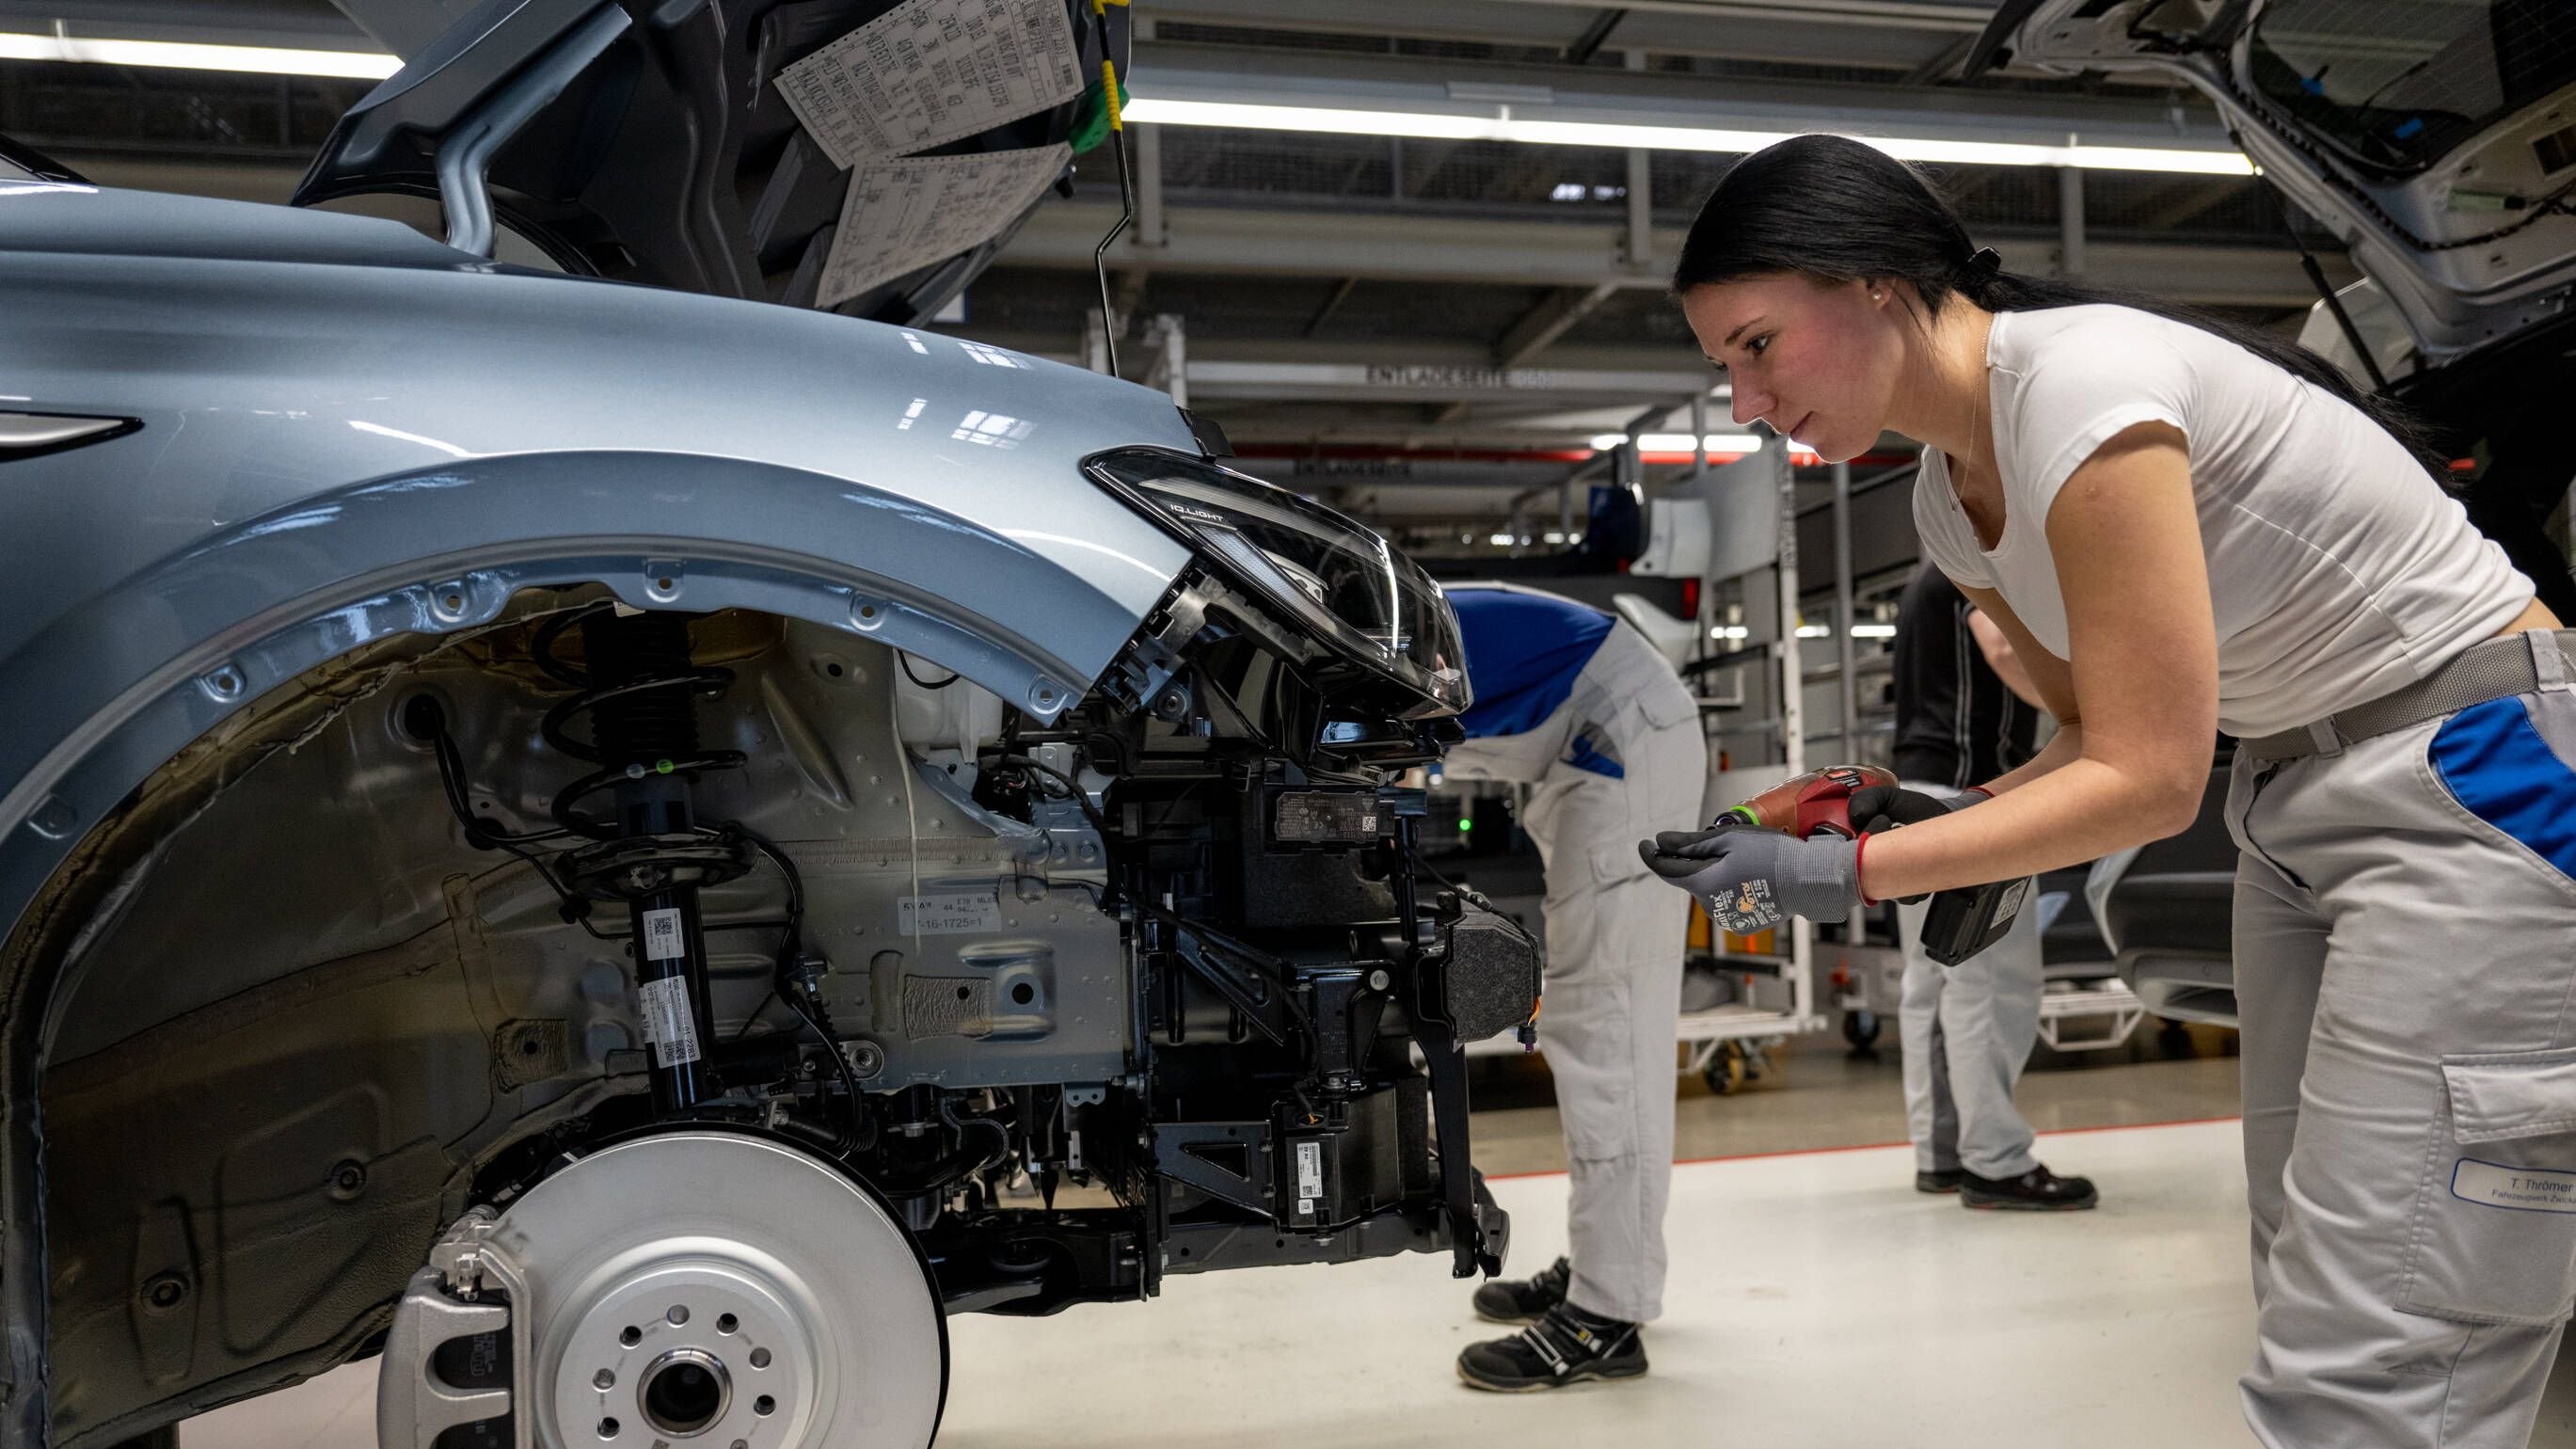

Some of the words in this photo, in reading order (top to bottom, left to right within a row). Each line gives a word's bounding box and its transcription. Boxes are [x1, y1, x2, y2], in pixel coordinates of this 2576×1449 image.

[1170, 504, 1223, 521] IQ.LIGHT
[1712, 894, 1733, 931] axiFlex
[918, 917, 982, 929] -16-1725=1
[2511, 1177, 2520, 1189] T.
[2526, 1179, 2575, 1192] Thrömer
[2491, 1188, 2548, 1202] Fahrzeugwerk
